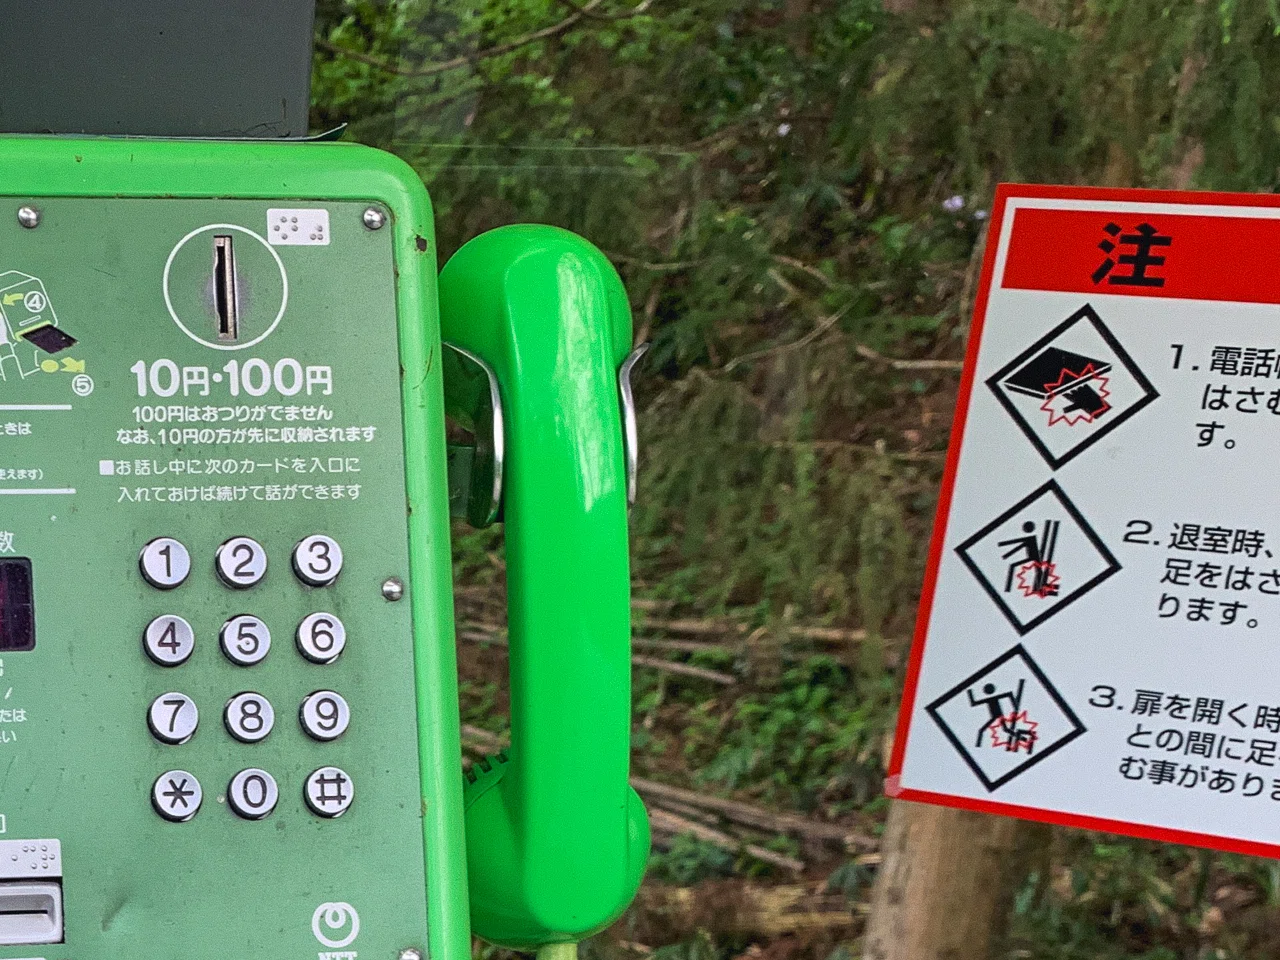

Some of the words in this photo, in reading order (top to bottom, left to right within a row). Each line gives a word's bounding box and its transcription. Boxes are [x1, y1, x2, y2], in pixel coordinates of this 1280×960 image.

[1091, 222, 1172, 288] 注
[1170, 344, 1280, 380] 1.電話
[132, 405, 333, 423] 100円はおつりがでません
[1196, 421, 1236, 449] す。
[116, 458, 361, 475] お話し中に次のカードを入口に
[117, 483, 362, 502] 入れておけば続けて話ができます
[158, 544, 172, 577] 1
[233, 543, 256, 577] 2
[308, 541, 331, 575] 3
[1158, 592, 1258, 629] ります。
[157, 621, 180, 655] 4
[237, 622, 260, 656] 5
[311, 618, 335, 653] 6
[163, 699, 186, 733] 7
[240, 699, 264, 734] 8
[315, 697, 338, 732] 9
[1126, 723, 1280, 767] との間に足
[243, 774, 267, 809] 0
